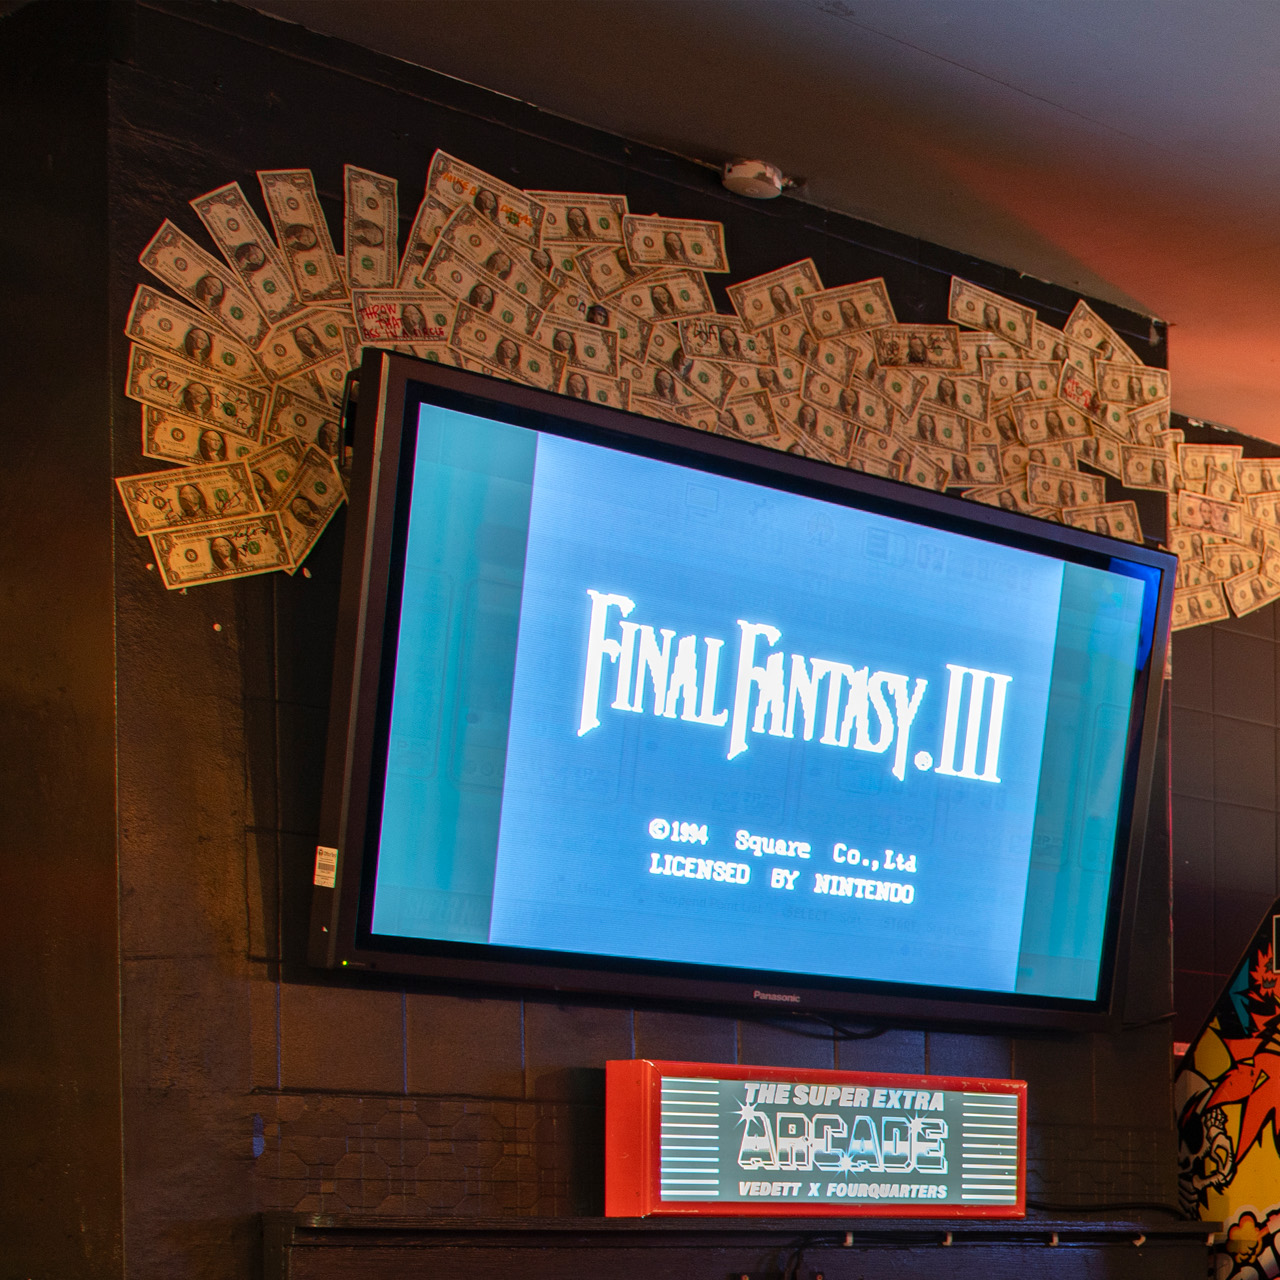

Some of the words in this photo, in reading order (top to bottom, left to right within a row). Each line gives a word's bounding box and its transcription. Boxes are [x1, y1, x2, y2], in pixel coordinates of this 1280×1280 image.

[577, 589, 728, 737] FINAL
[935, 663, 1013, 784] III
[735, 829, 811, 859] Square
[649, 852, 751, 885] LICENSED
[771, 867, 800, 890] BY
[814, 873, 915, 905] NINTENDO
[753, 990, 801, 1003] Panasonic
[744, 1082, 792, 1106] THE
[793, 1084, 870, 1109] SUPER
[872, 1088, 945, 1112] EXTRA
[737, 1110, 949, 1175] ARCADE
[738, 1181, 803, 1198] VEDETT
[808, 1183, 820, 1197] X
[826, 1183, 948, 1201] FOURQUARTERS
